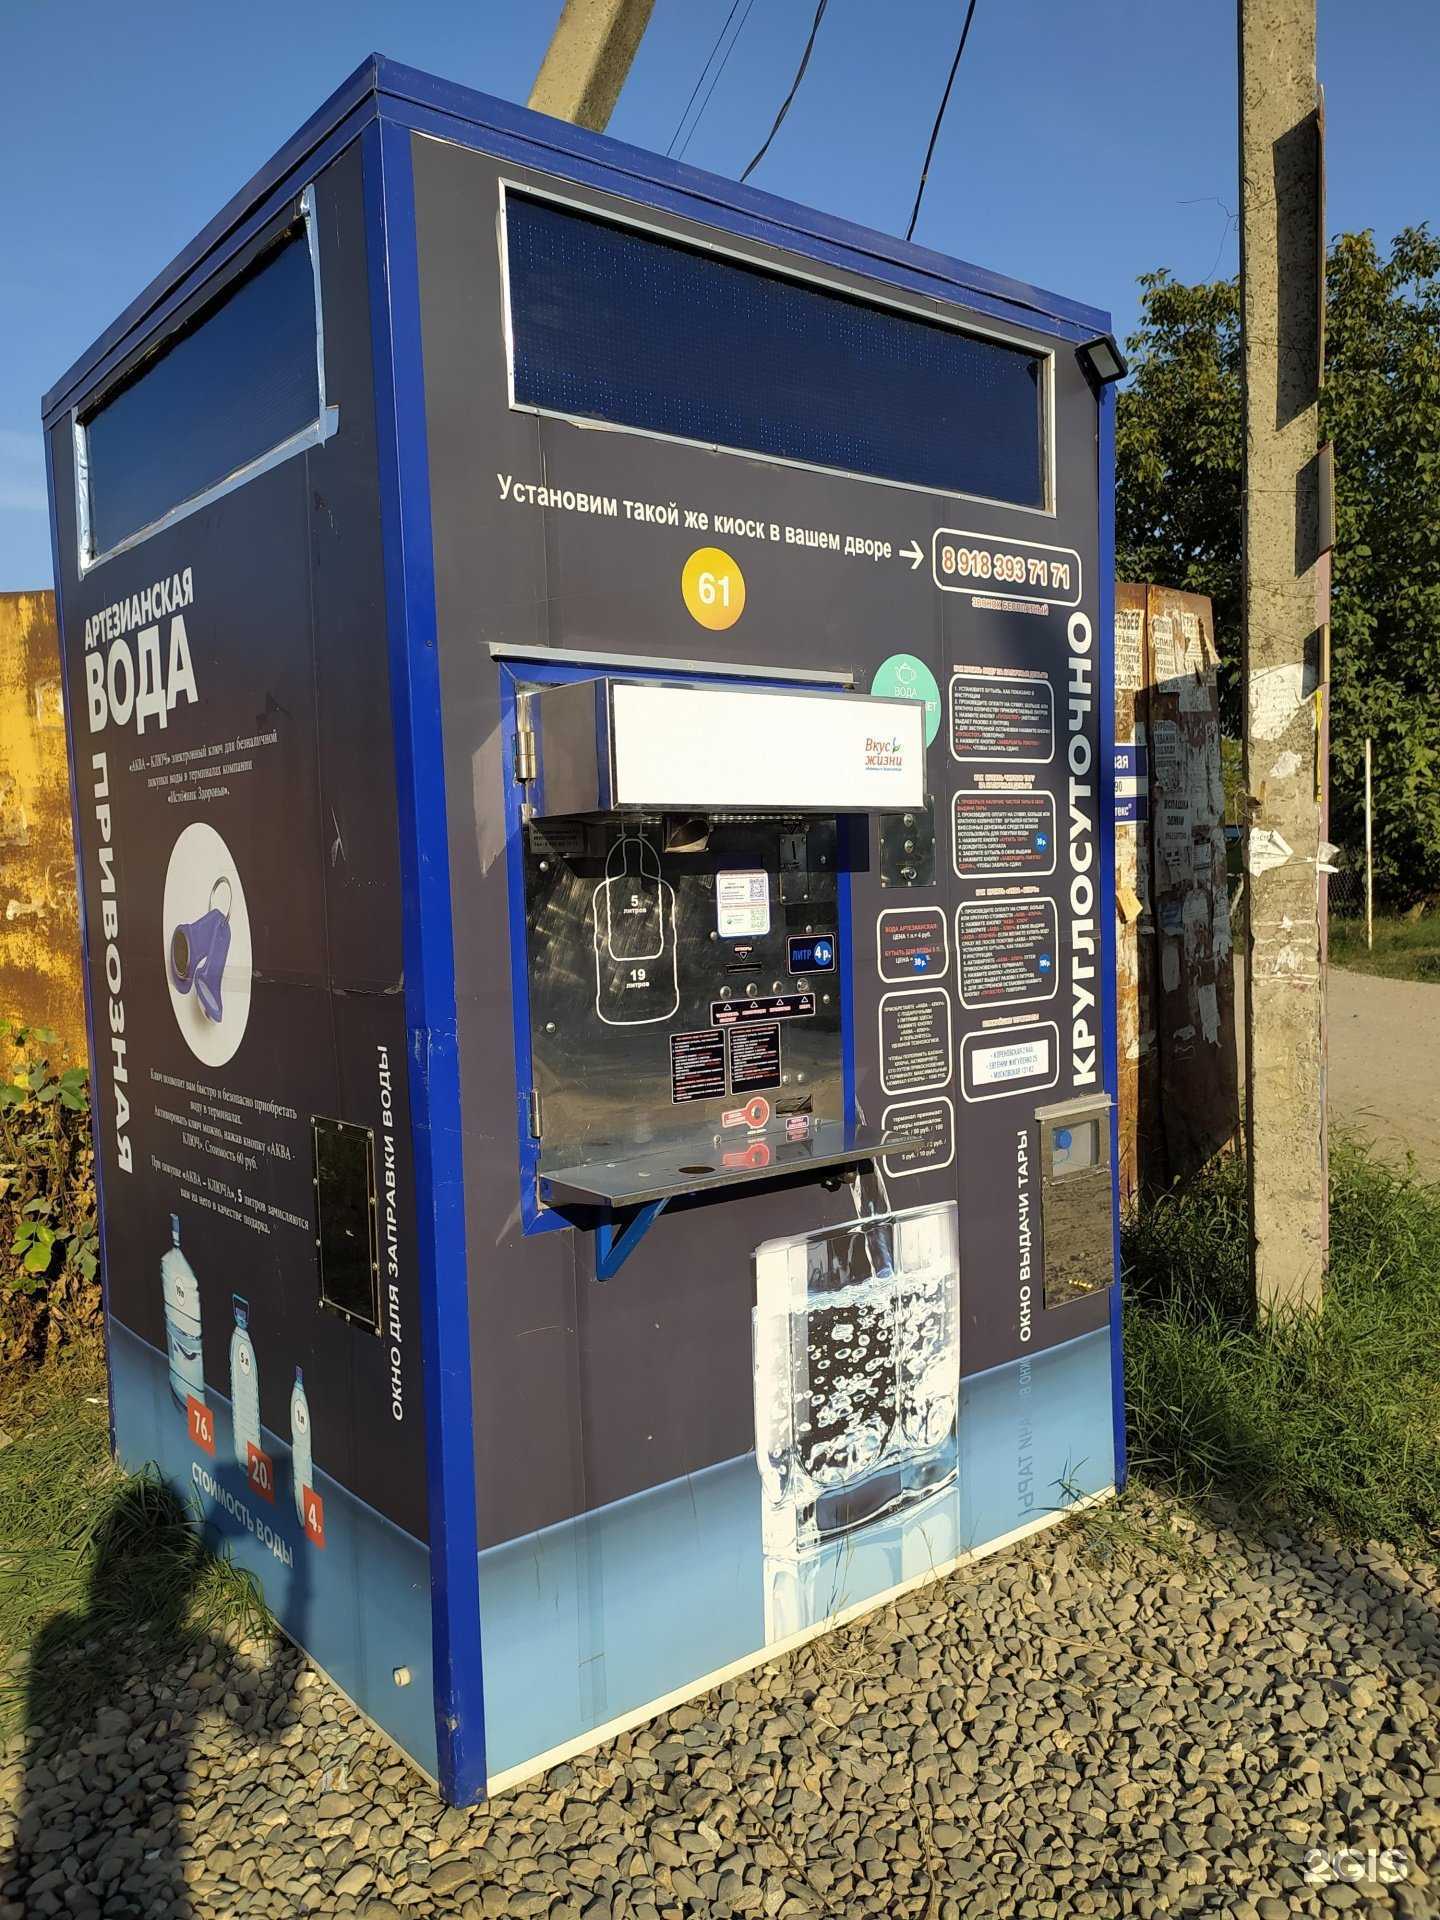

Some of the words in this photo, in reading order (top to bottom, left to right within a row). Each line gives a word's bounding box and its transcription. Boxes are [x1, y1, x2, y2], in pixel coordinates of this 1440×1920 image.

[497, 473, 618, 517] Установим
[623, 499, 679, 526] такой
[684, 509, 709, 531] же
[714, 515, 765, 540] киоск
[770, 522, 780, 542] в
[785, 526, 840, 551] вашем
[845, 536, 892, 561] дворе
[699, 572, 730, 606] 61
[942, 545, 955, 574] 8
[957, 548, 992, 579] 918
[994, 553, 1025, 583] 393
[1027, 559, 1047, 587] 71
[1051, 563, 1070, 590] 71
[84, 566, 194, 651] АРТЕЗИАНСКАЯ
[84, 614, 199, 735] ВОДА
[895, 686, 918, 698] ВОДА
[865, 738, 891, 755] Вкус
[1067, 611, 1097, 1087] КРУГЛОСУТОЧНО
[631, 895, 639, 907] 5
[92, 752, 133, 1175] ПРИВОЗНАЯ
[630, 968, 646, 981] 19
[792, 949, 812, 961] ЛИТР
[626, 980, 650, 989] литров
[197, 1080, 217, 1101] быстро
[222, 1087, 254, 1108] безопасно
[254, 1098, 298, 1120] приобретать
[377, 1045, 393, 1128] ВОДЫ
[205, 1139, 236, 1162] Стоимость
[223, 1131, 243, 1145] нажав
[243, 1135, 266, 1156] кнопку
[267, 1141, 291, 1161] «АКВА
[1017, 1130, 1029, 1189] ТАРЫ
[217, 1204, 243, 1222] качестве
[238, 1188, 243, 1203] 5
[243, 1195, 267, 1215] литров
[267, 1204, 309, 1231] зачисляются
[384, 1135, 399, 1278] ЗАПРАВКИ
[1018, 1192, 1032, 1281] ВЫДАЧИ
[389, 1284, 402, 1343] ДЛЯ
[1019, 1285, 1031, 1342] ОКНО
[390, 1346, 403, 1421] ОКНО
[192, 1462, 254, 1532] СТОИМОСТЬ
[256, 1518, 293, 1569] ВОДЫ
